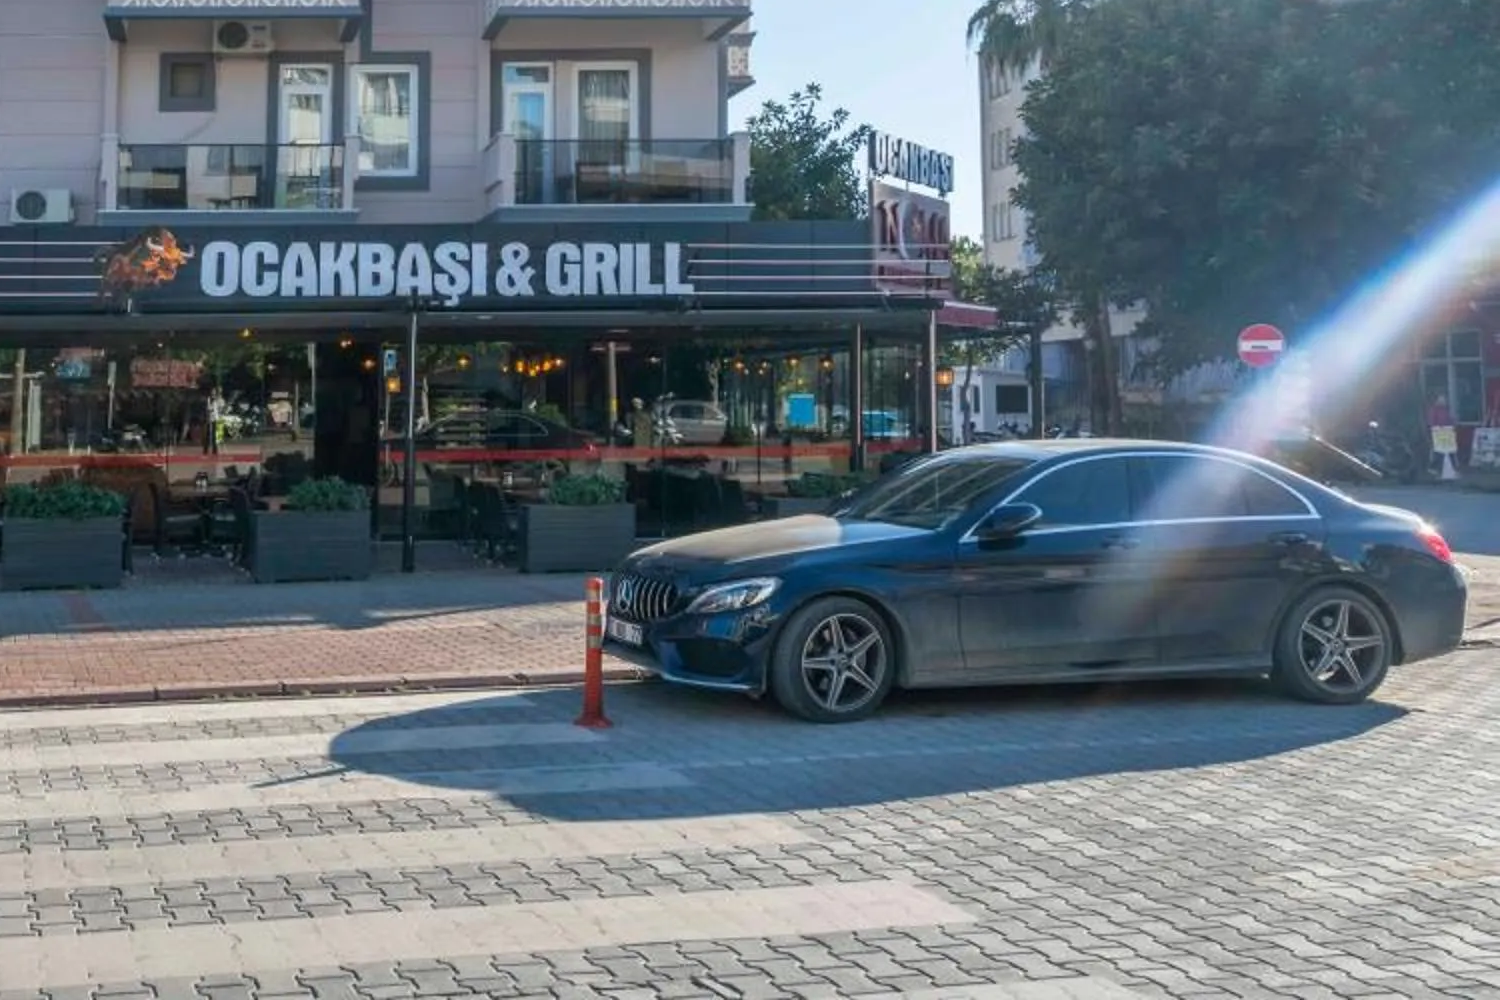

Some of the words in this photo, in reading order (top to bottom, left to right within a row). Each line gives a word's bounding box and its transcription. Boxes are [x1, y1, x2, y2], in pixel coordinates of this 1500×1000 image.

[201, 241, 487, 306] OCAKBAŞI
[495, 241, 536, 298] &
[545, 242, 695, 297] GRILL
